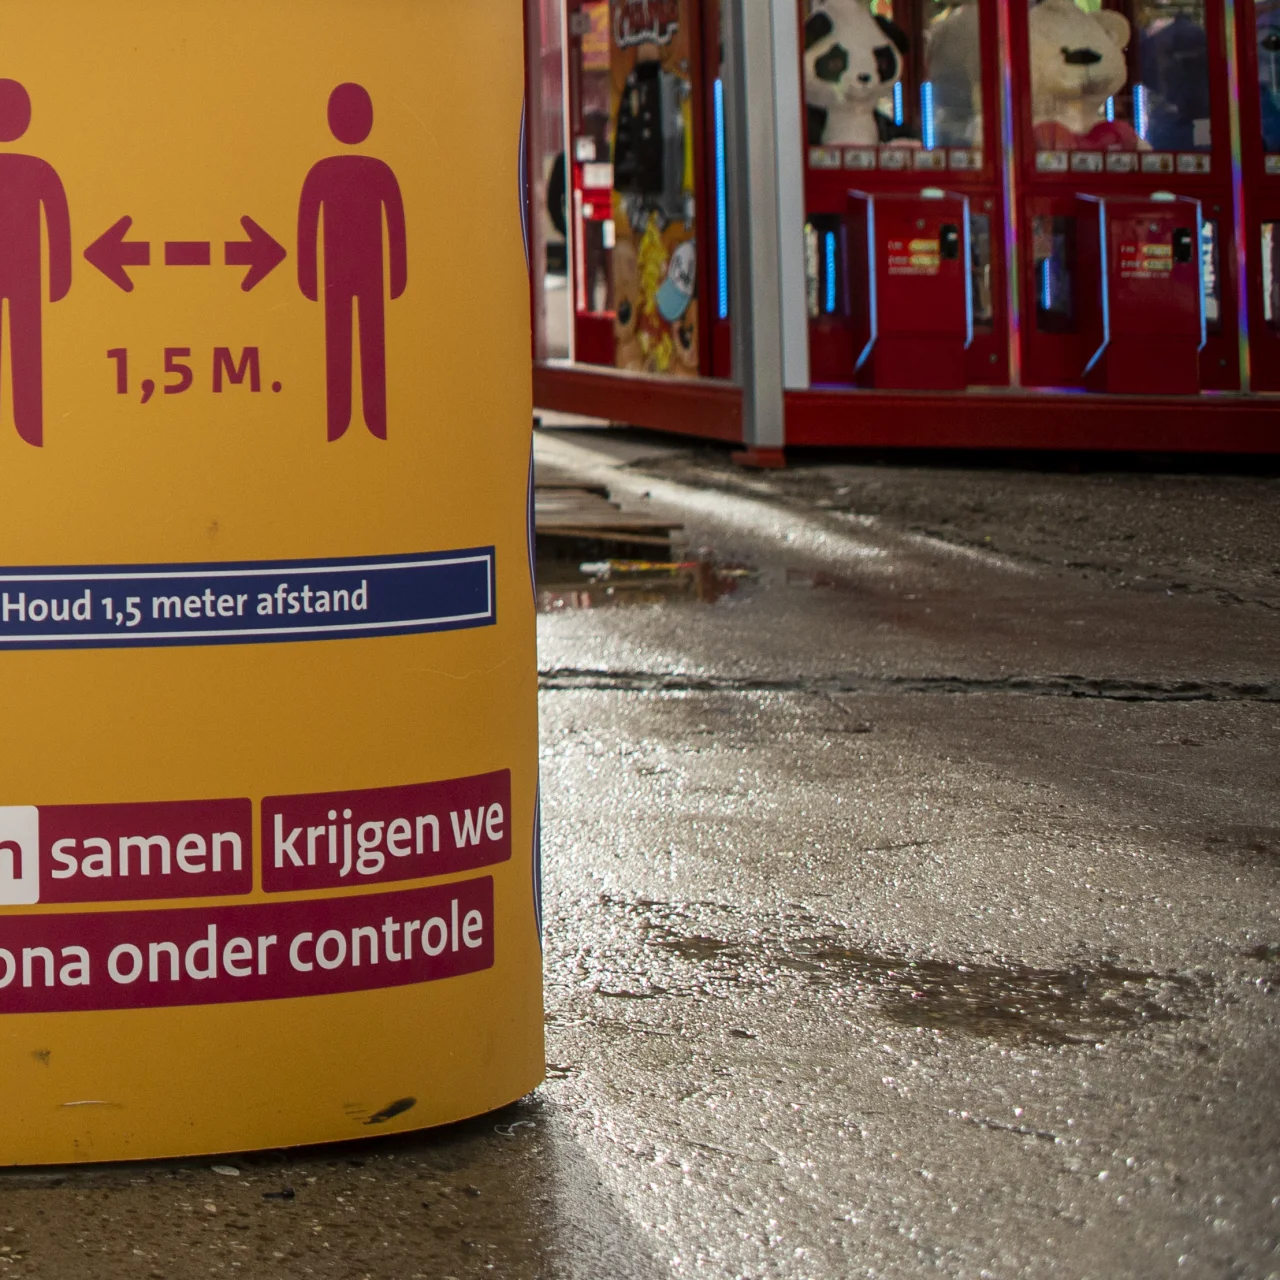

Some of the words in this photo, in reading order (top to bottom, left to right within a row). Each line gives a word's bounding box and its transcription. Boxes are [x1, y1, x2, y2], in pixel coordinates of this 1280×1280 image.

[106, 347, 193, 404] 1,5
[1, 588, 92, 623] Houd
[102, 595, 142, 627] 1,5
[151, 588, 248, 620] meter
[256, 580, 368, 615] afstand
[50, 830, 242, 880] samen
[273, 809, 440, 877] krijgen
[450, 800, 505, 848] we
[107, 924, 277, 983] onder
[289, 899, 484, 972] controle
